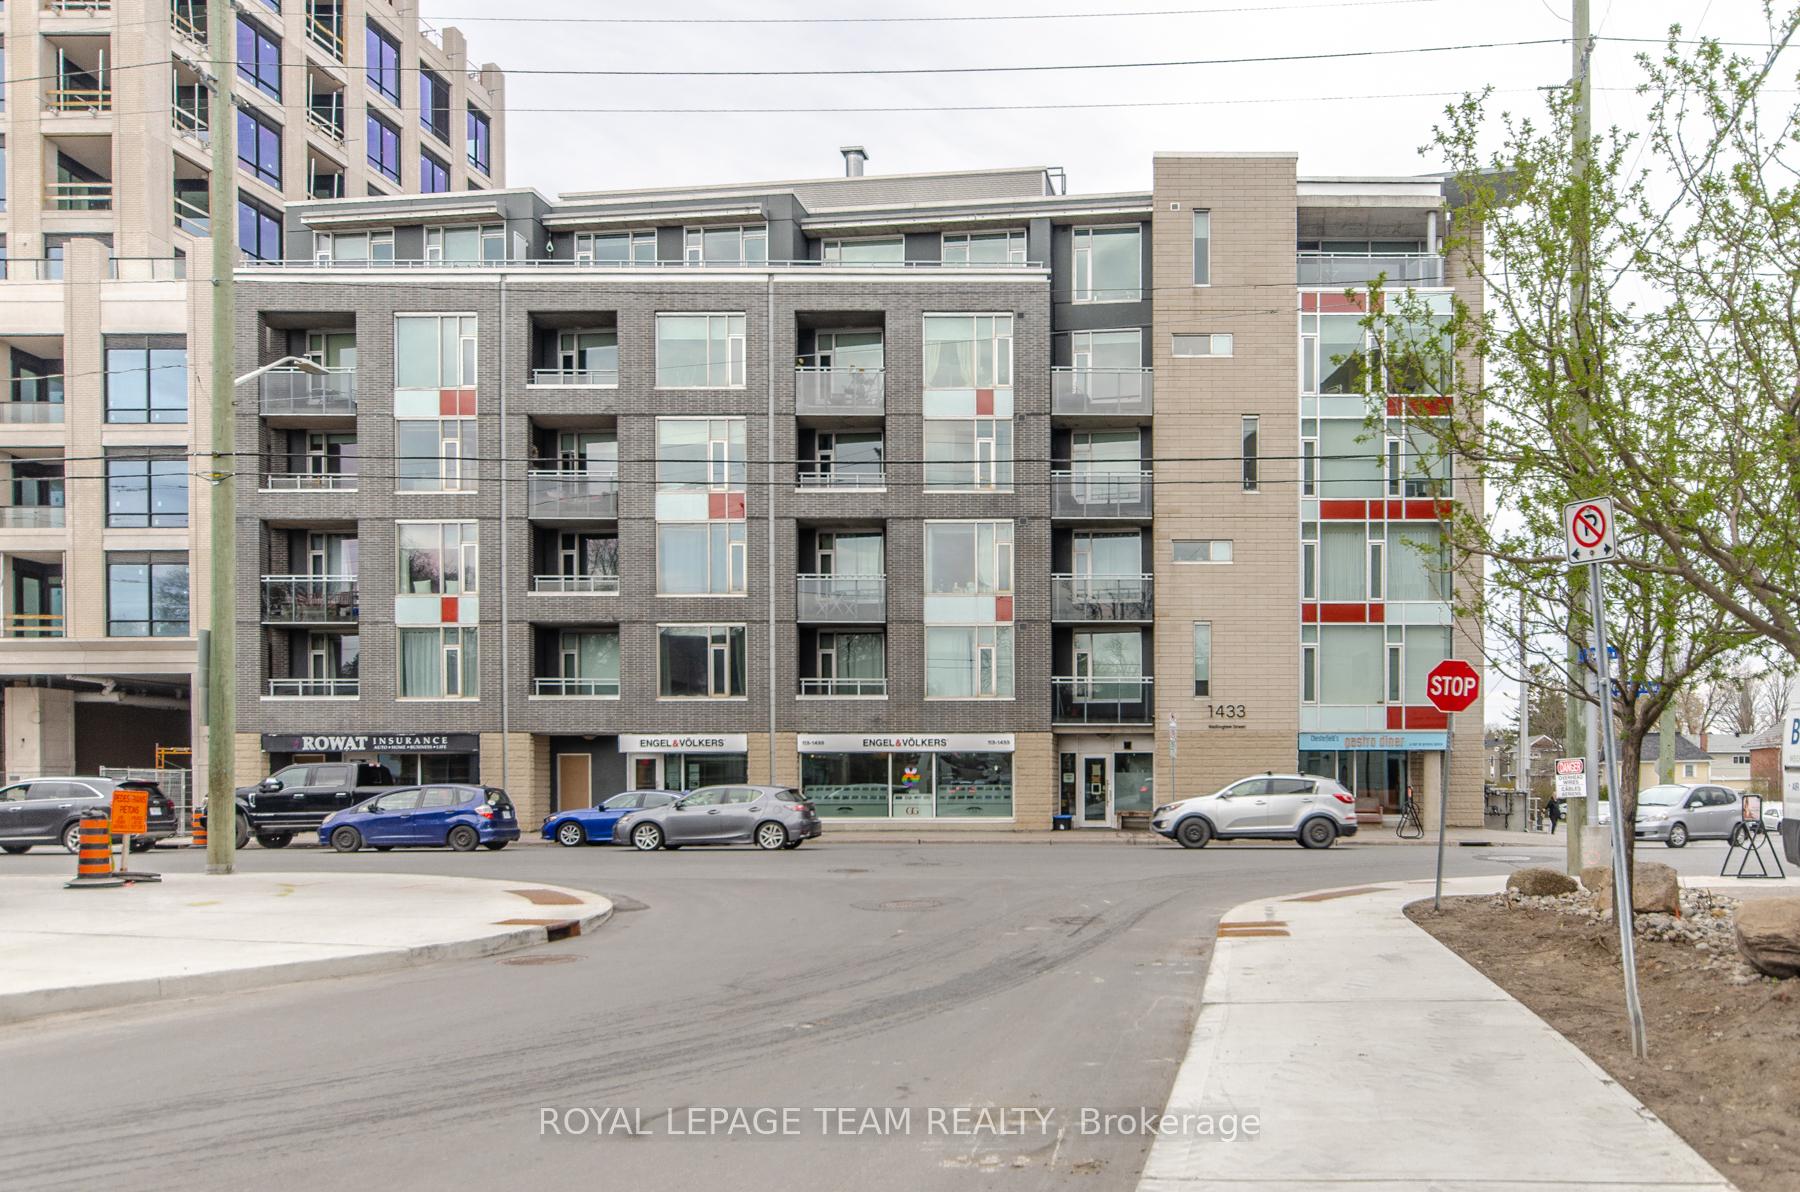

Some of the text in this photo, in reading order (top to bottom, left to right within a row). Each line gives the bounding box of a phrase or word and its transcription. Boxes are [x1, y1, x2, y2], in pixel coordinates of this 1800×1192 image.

[1430, 675, 1477, 697] STOP
[1208, 704, 1246, 718] 1433
[302, 736, 448, 751] ROWAT INSURANCE
